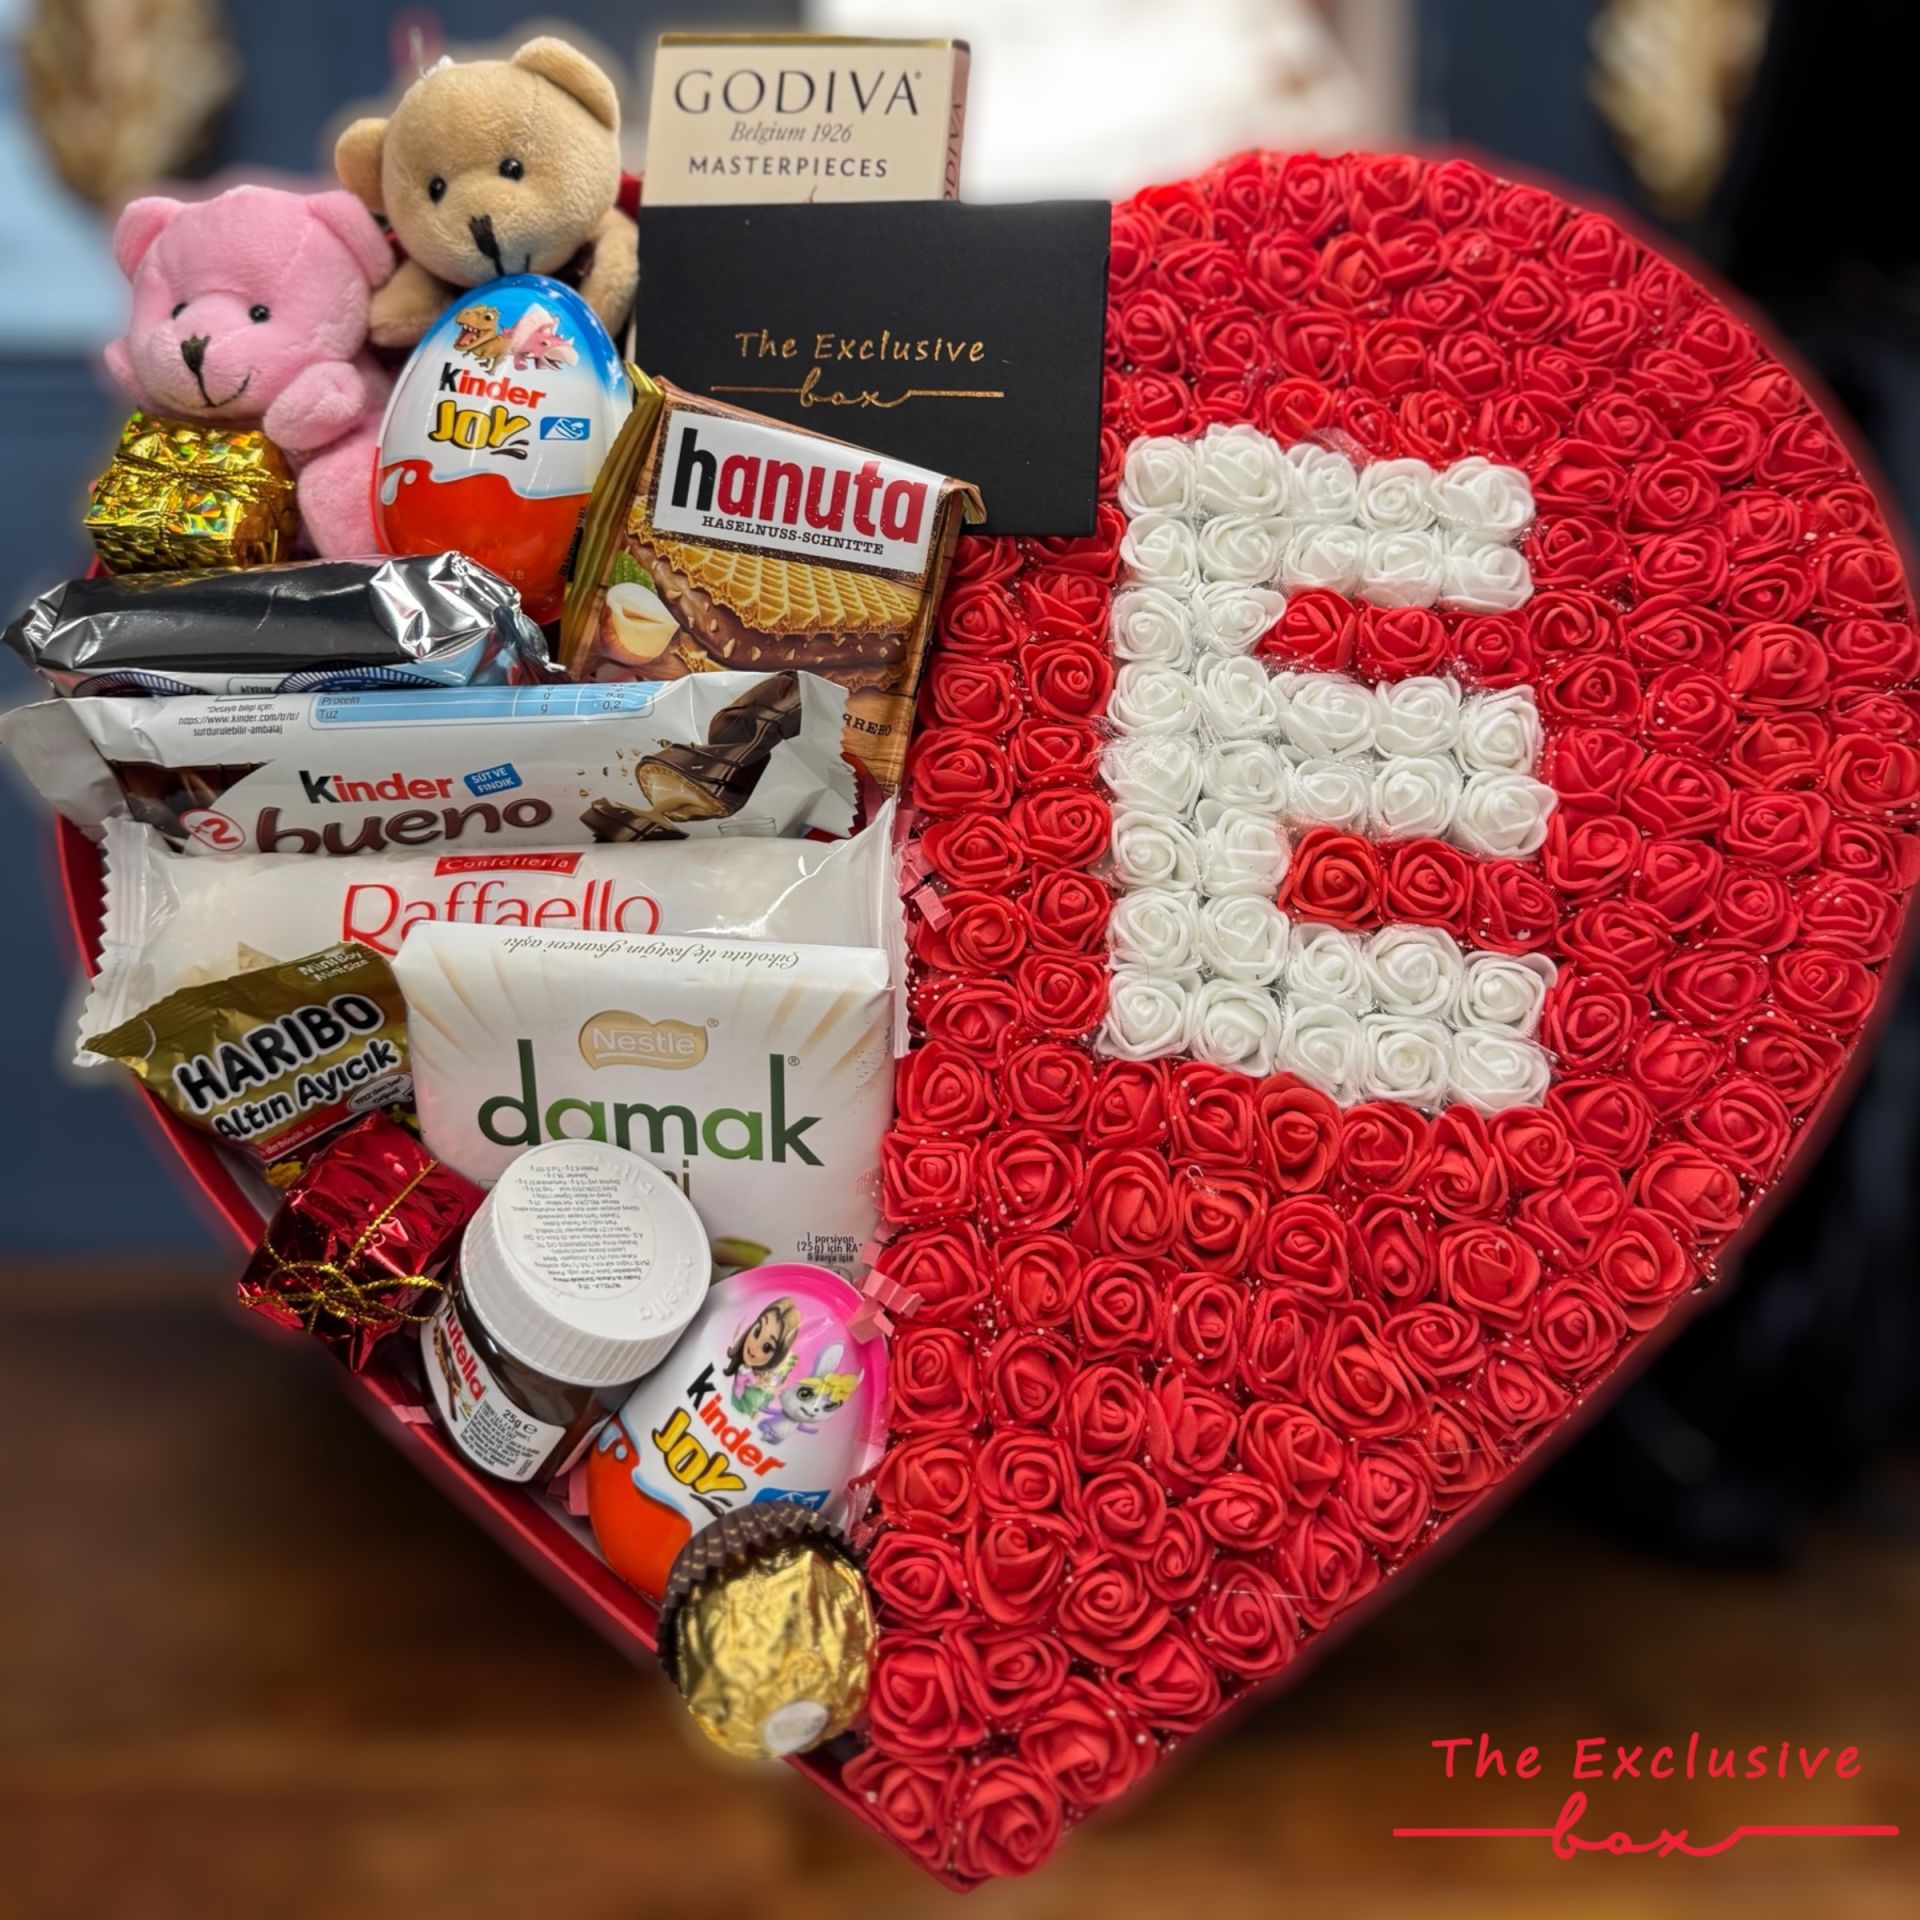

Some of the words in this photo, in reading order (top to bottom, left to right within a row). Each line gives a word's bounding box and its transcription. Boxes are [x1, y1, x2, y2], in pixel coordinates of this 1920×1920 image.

[673, 68, 919, 116] GODIVA
[729, 121, 806, 145] Belgium
[810, 123, 854, 143] 1926
[688, 155, 889, 177] MASTERPIECES
[735, 330, 797, 360] The
[813, 329, 986, 363] Exclusive
[670, 427, 929, 545] hanuta
[701, 515, 885, 556] HASELNUSS-SCHNITTE
[319, 709, 338, 719] Tuz
[540, 704, 548, 714] g
[471, 772, 492, 784] SÜT
[492, 767, 508, 778] VE
[477, 777, 515, 793] FINDIK
[255, 798, 553, 854] bueno
[445, 855, 569, 871] Confetteria
[342, 879, 661, 956] Raffaello
[692, 944, 717, 964] ile
[718, 949, 800, 971] Çikolata
[175, 995, 383, 1112] HARIBO
[213, 1092, 296, 1140] Altın
[295, 1039, 400, 1107] Ayıcık
[477, 1038, 826, 1167] damak
[815, 1234, 855, 1246] porsiyon
[501, 1408, 523, 1429] 25g
